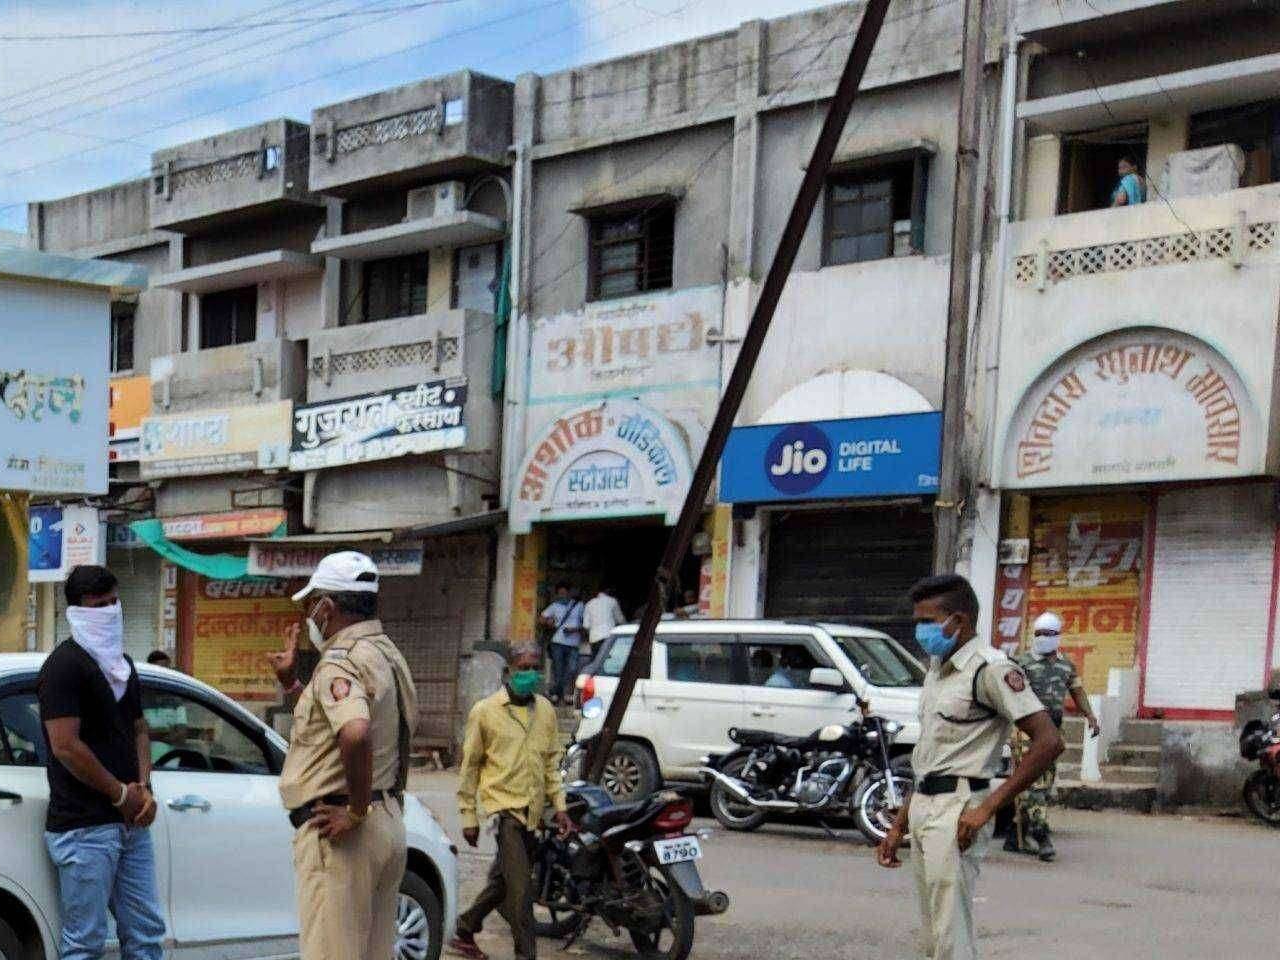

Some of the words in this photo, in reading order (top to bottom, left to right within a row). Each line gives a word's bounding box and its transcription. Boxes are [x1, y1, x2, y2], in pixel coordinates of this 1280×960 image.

[770, 439, 828, 476] Jio
[837, 438, 902, 457] DIGITAL
[837, 456, 873, 473] LIFE
